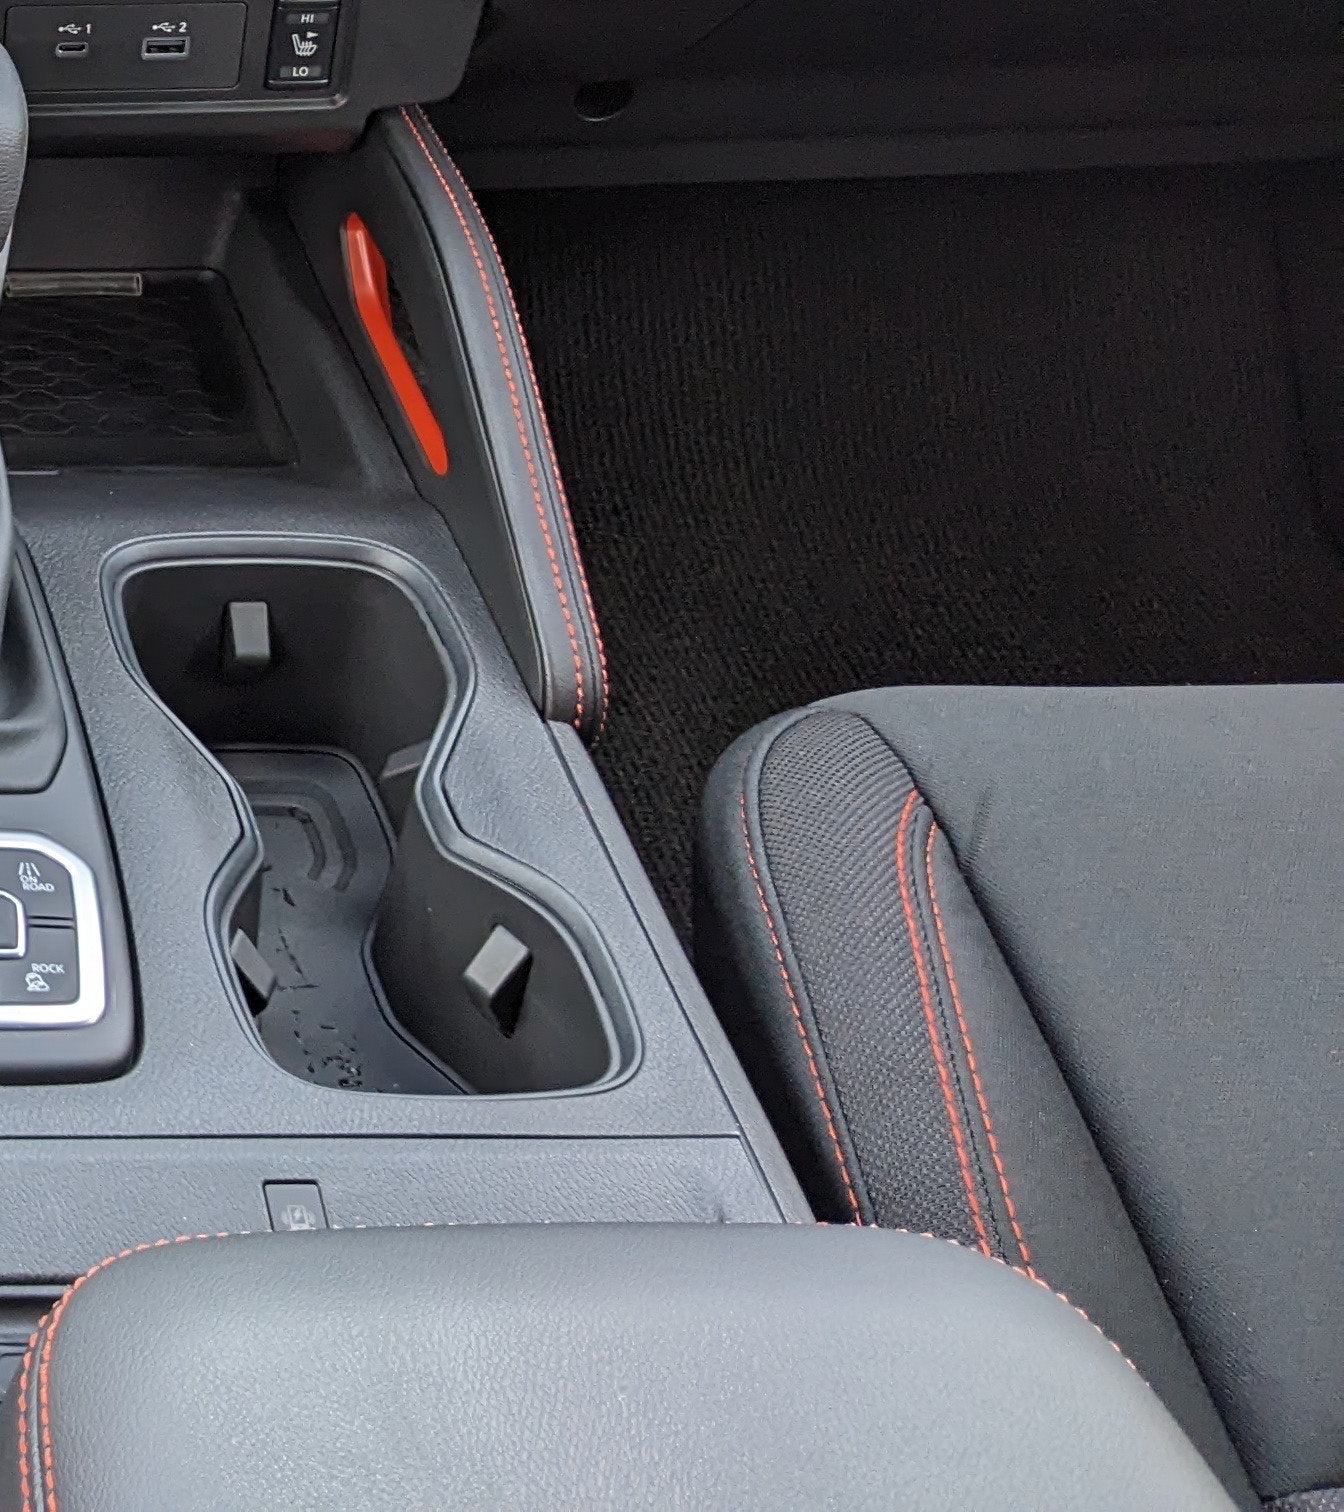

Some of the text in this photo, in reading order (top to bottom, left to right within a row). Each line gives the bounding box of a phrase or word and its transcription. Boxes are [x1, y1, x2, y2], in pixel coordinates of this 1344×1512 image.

[301, 13, 315, 25] HI
[292, 66, 310, 78] LO
[22, 882, 55, 892] ROAD
[31, 963, 65, 974] ROCK
